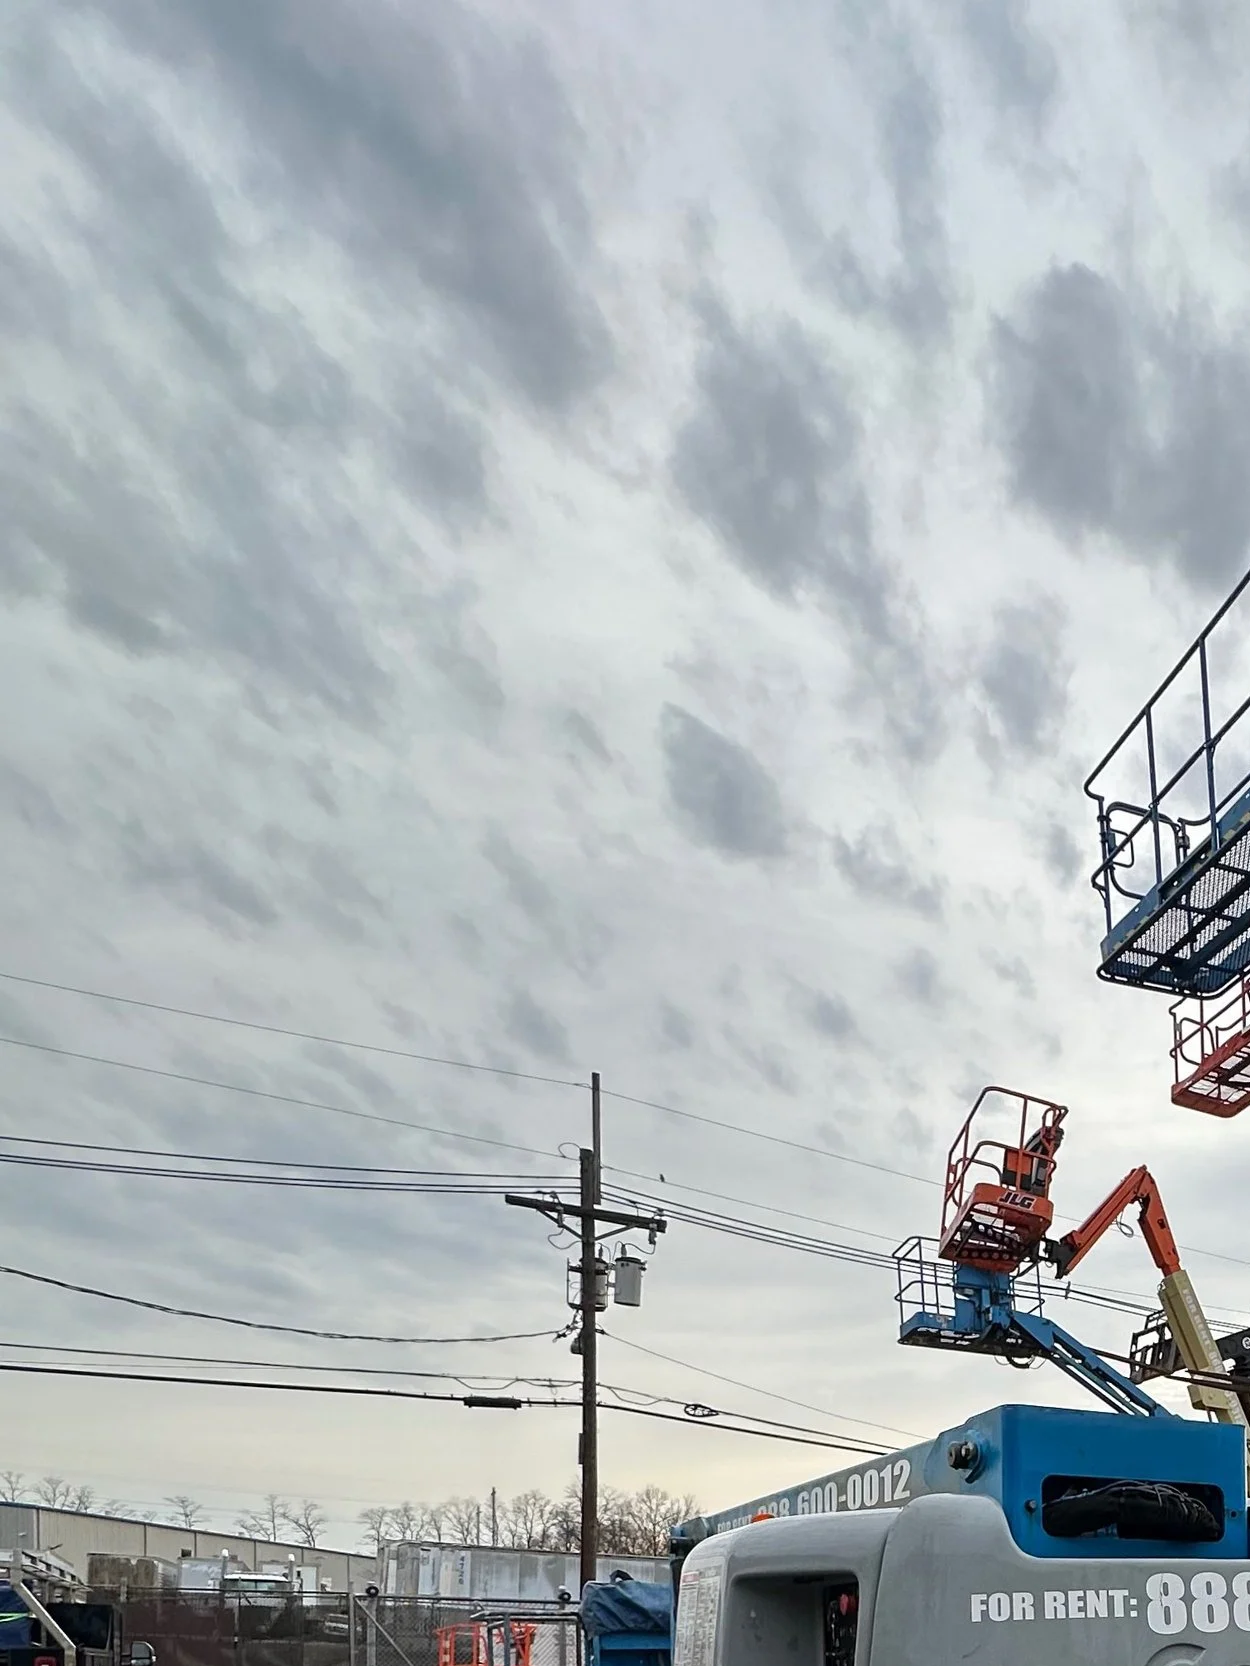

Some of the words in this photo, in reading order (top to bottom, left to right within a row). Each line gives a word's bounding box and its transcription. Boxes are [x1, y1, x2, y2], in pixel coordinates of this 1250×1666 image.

[999, 1191, 1035, 1209] JLG
[970, 1592, 1036, 1622] FOR
[1044, 1588, 1138, 1619] RENT:
